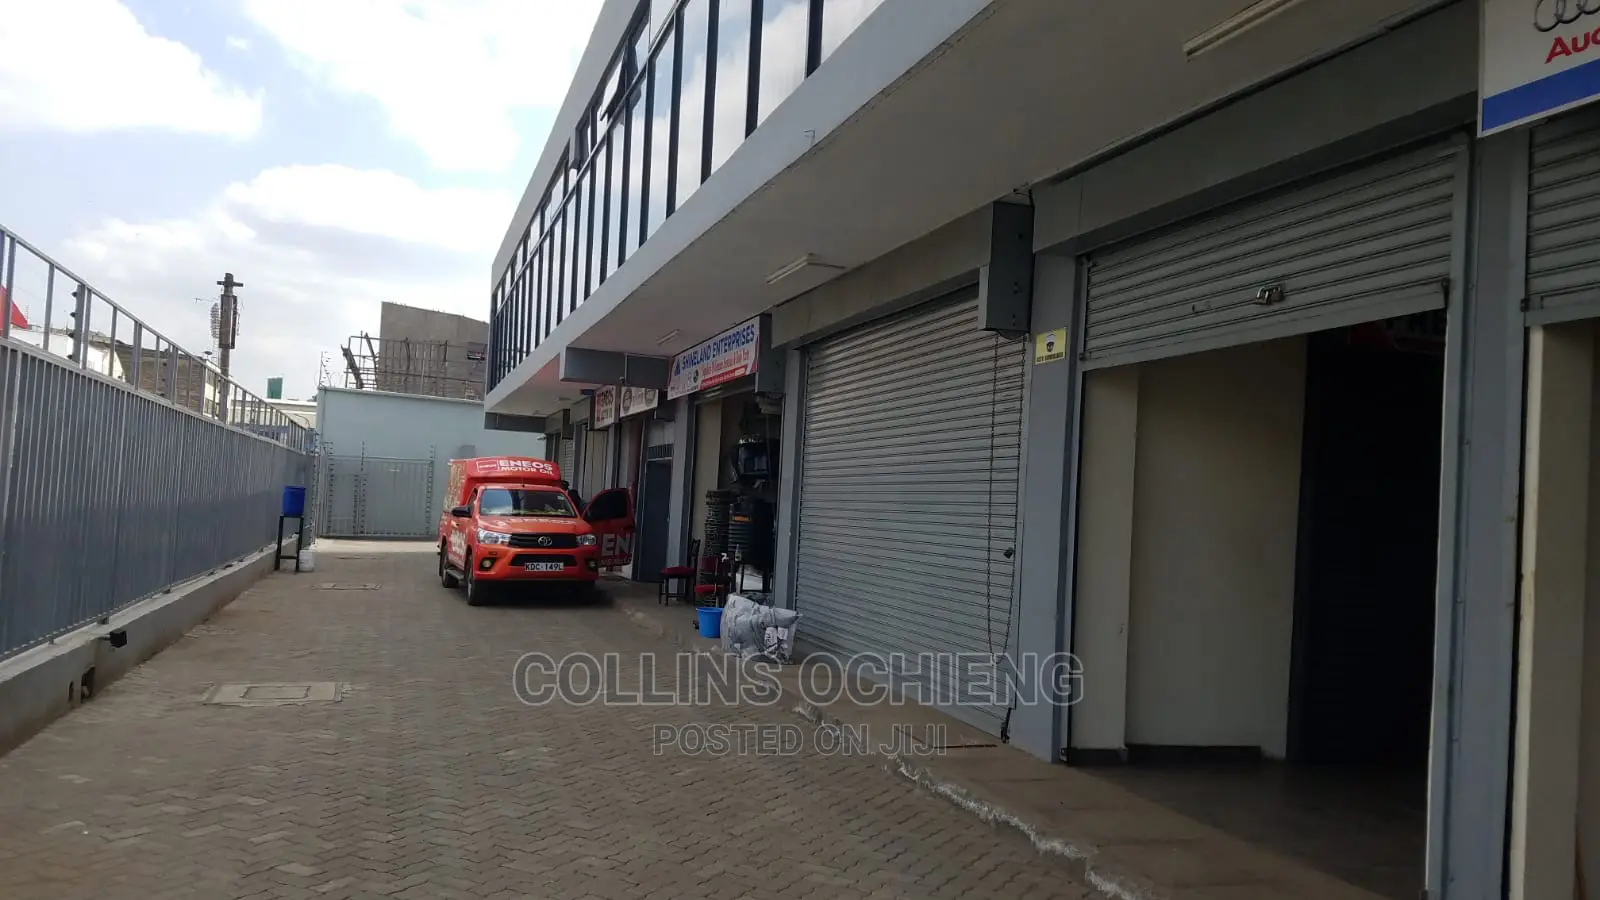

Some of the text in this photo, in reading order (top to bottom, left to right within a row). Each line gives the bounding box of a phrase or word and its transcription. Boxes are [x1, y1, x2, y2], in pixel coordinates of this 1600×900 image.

[682, 344, 711, 370] SHINELAND
[712, 324, 755, 358] ENTERPRISES
[499, 460, 553, 471] ENEOS
